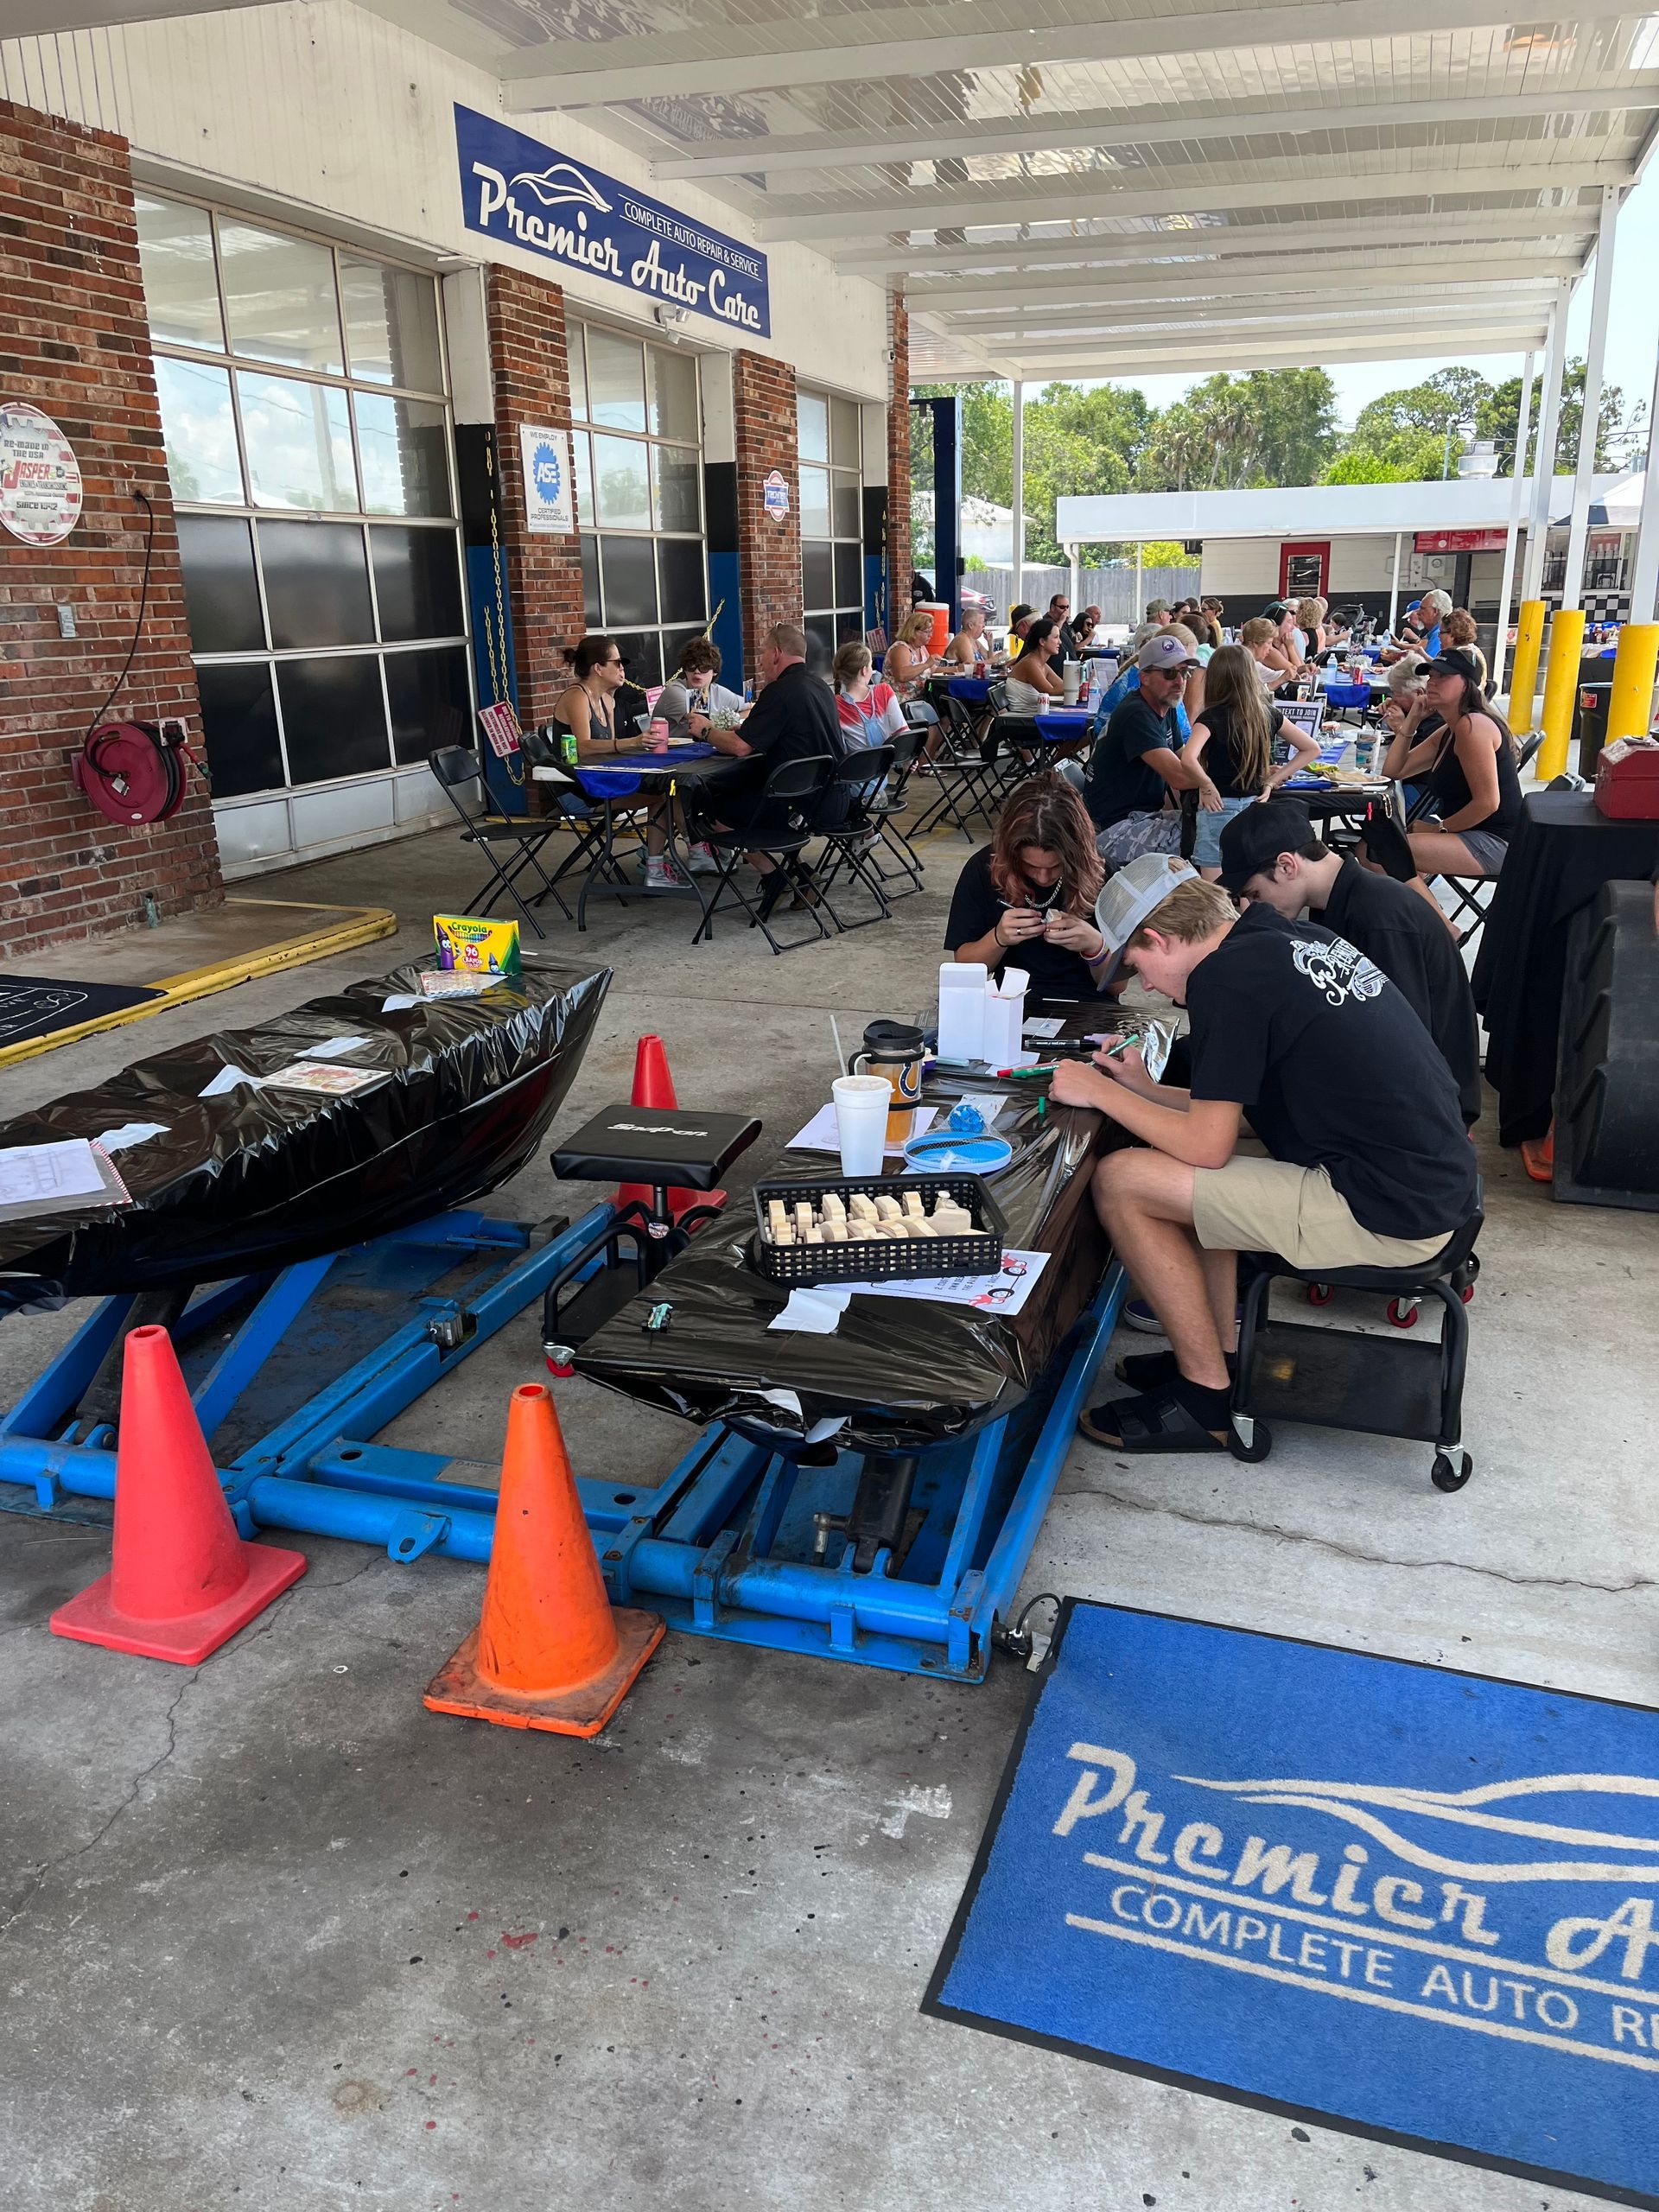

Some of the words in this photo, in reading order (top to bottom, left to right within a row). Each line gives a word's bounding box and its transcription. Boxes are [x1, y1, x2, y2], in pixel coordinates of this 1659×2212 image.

[473, 162, 623, 277] Premier
[631, 240, 706, 304] Auto
[709, 269, 761, 329] Care
[624, 201, 671, 237] COMPLETE
[673, 220, 696, 248] AUTO
[697, 233, 723, 261] REPAIR
[723, 249, 730, 263] &
[730, 253, 759, 276] SERVICE
[3, 460, 50, 489] JASPER
[537, 462, 557, 483] ASE
[531, 513, 569, 522] PROFESSIONALS
[451, 921, 487, 933] Crayola
[465, 945, 478, 957] 96
[1052, 1742, 1499, 1947] Premier
[1110, 1885, 1396, 1988] COMPLETE
[1421, 1964, 1580, 2031] AUTO
